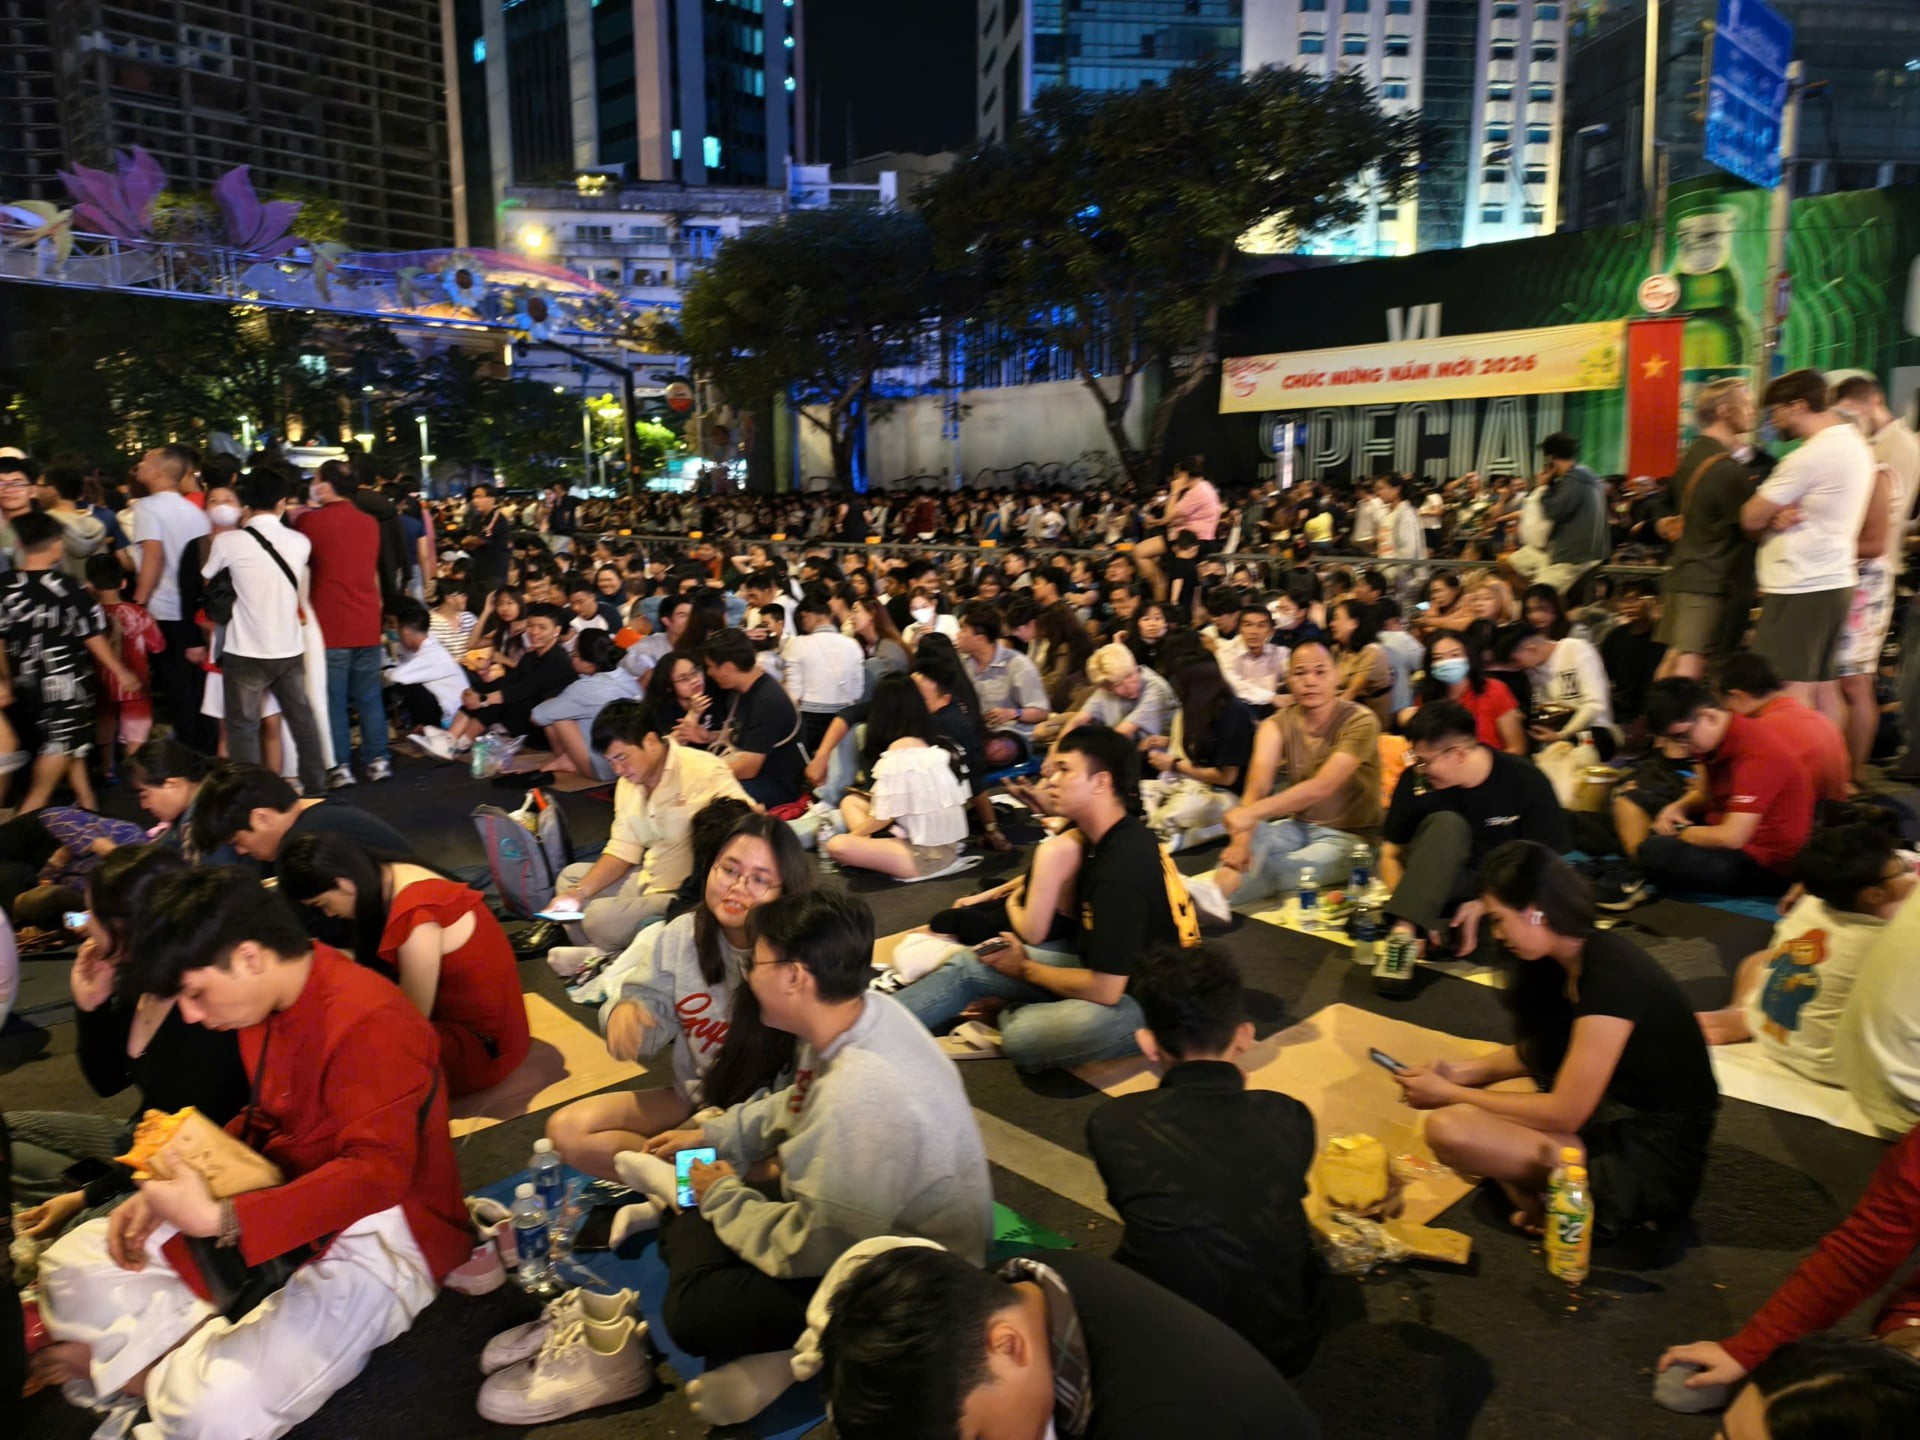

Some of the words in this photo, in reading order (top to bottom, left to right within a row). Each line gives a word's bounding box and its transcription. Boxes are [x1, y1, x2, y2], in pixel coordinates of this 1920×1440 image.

[1281, 369, 1326, 390] CHÚC
[1435, 355, 1477, 378] MỚI
[1479, 354, 1539, 375] 2026
